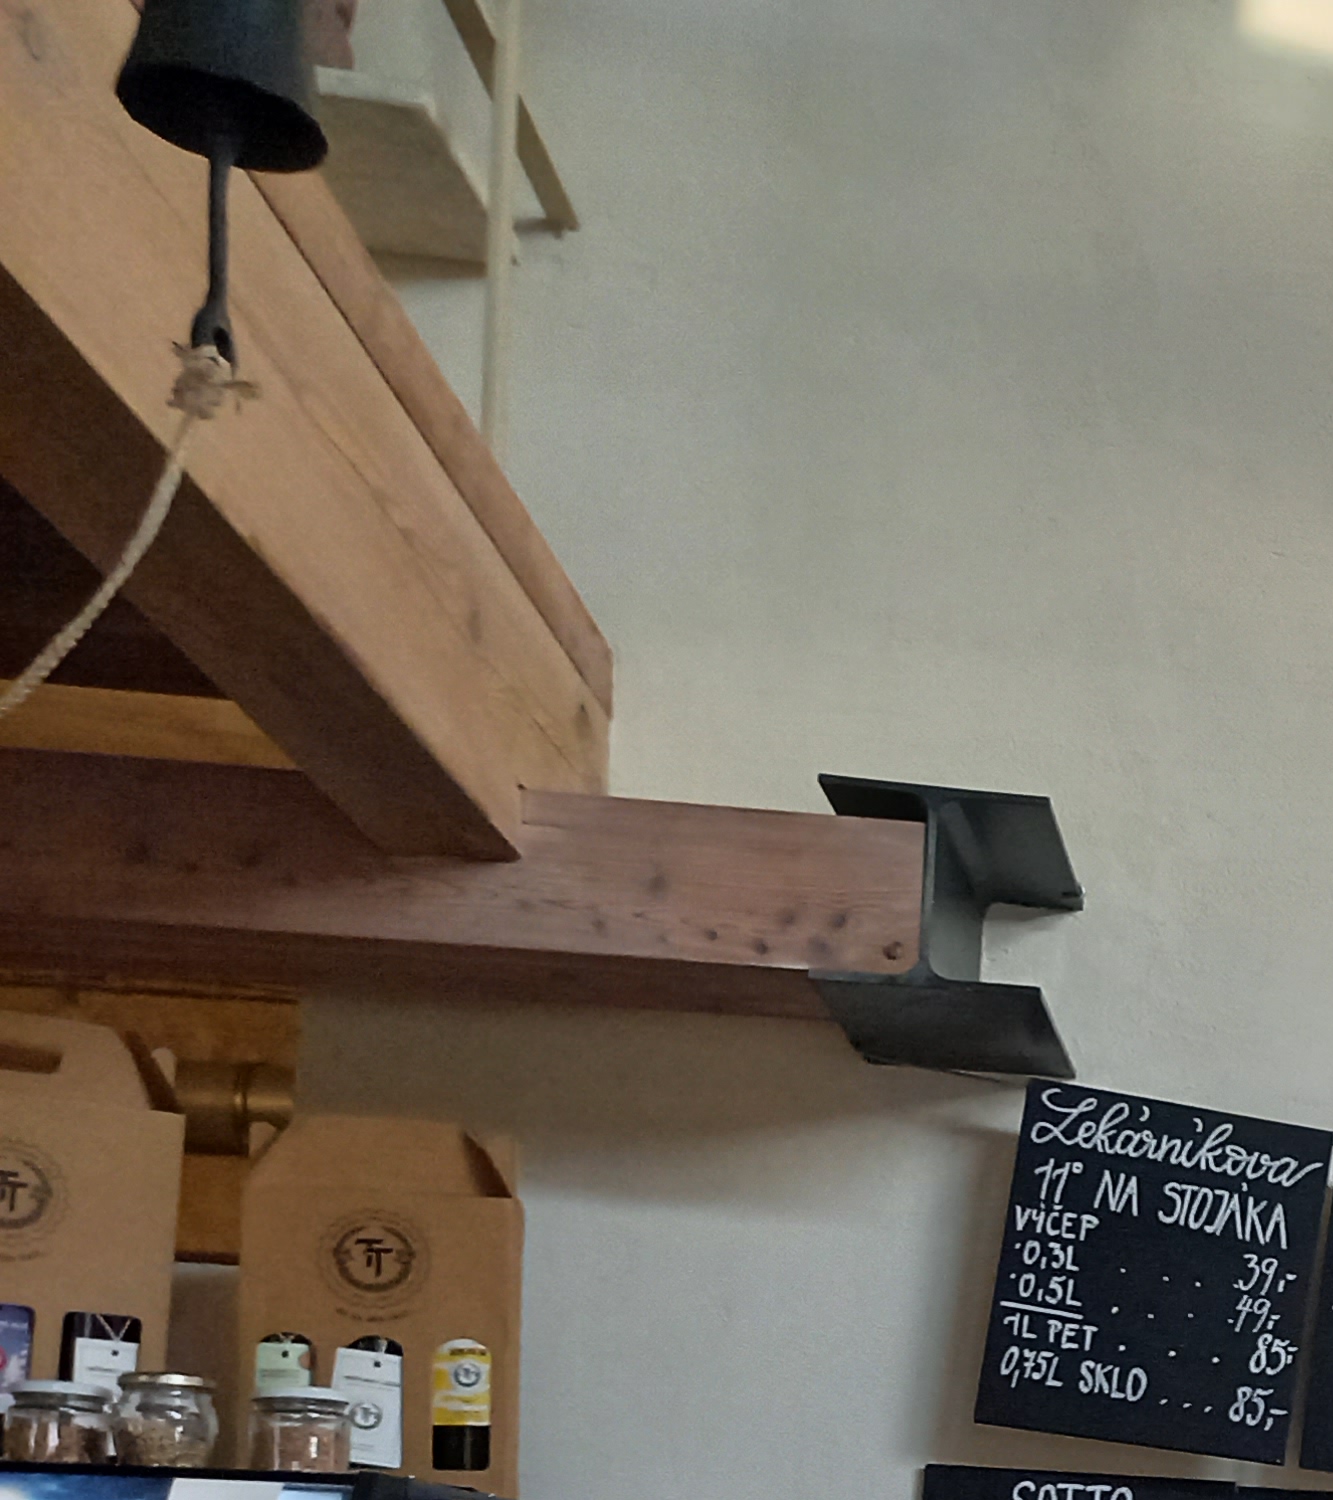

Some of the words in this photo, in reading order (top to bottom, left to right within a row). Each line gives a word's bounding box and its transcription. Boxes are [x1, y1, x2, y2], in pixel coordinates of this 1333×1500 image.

[1016, 1202, 1099, 1241] VÝČEP
[1094, 1170, 1138, 1216] NA
[1159, 1182, 1287, 1249] STOJÁKA
[1023, 1240, 1079, 1271] 0,3L
[1019, 1273, 1082, 1306] 0,5L
[1003, 1313, 1037, 1338] 1L
[1047, 1320, 1098, 1351] PET
[1001, 1346, 1063, 1388] 0,75L
[1079, 1360, 1147, 1401] SKLO
